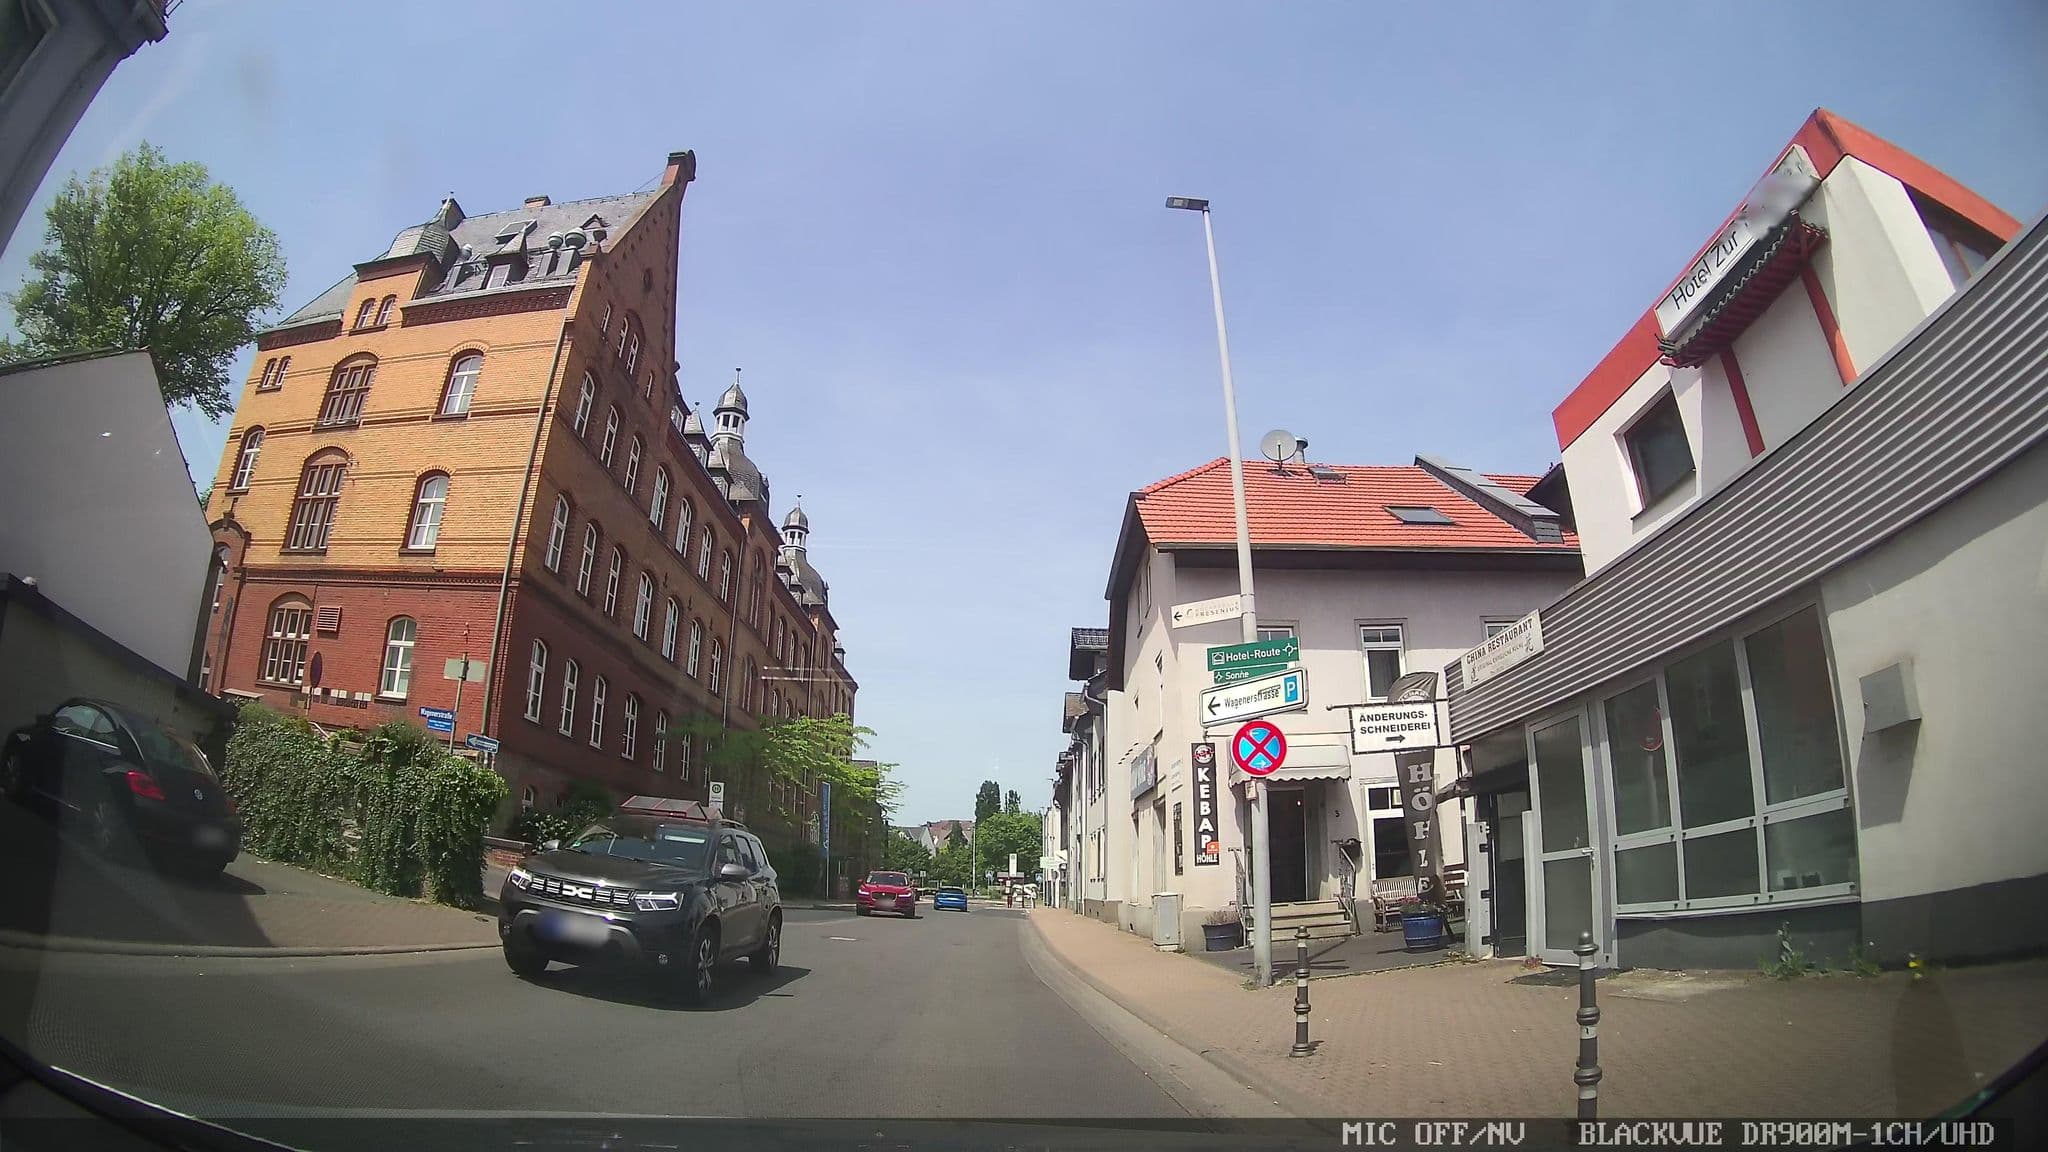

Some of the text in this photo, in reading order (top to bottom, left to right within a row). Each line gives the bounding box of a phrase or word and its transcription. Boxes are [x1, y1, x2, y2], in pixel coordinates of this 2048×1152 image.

[1671, 230, 1740, 310] Hotel Zur
[1466, 647, 1487, 665] CHINA
[1487, 618, 1533, 653] RESTAURANT
[1226, 647, 1281, 662] Hotel-Route
[1225, 670, 1250, 680] Sonne
[1224, 682, 1296, 709] Wagenerstrasse P
[1360, 722, 1431, 734] SCHNEIDEREI
[1197, 767, 1215, 849] KEBAP
[1196, 852, 1218, 863] HÖHLE
